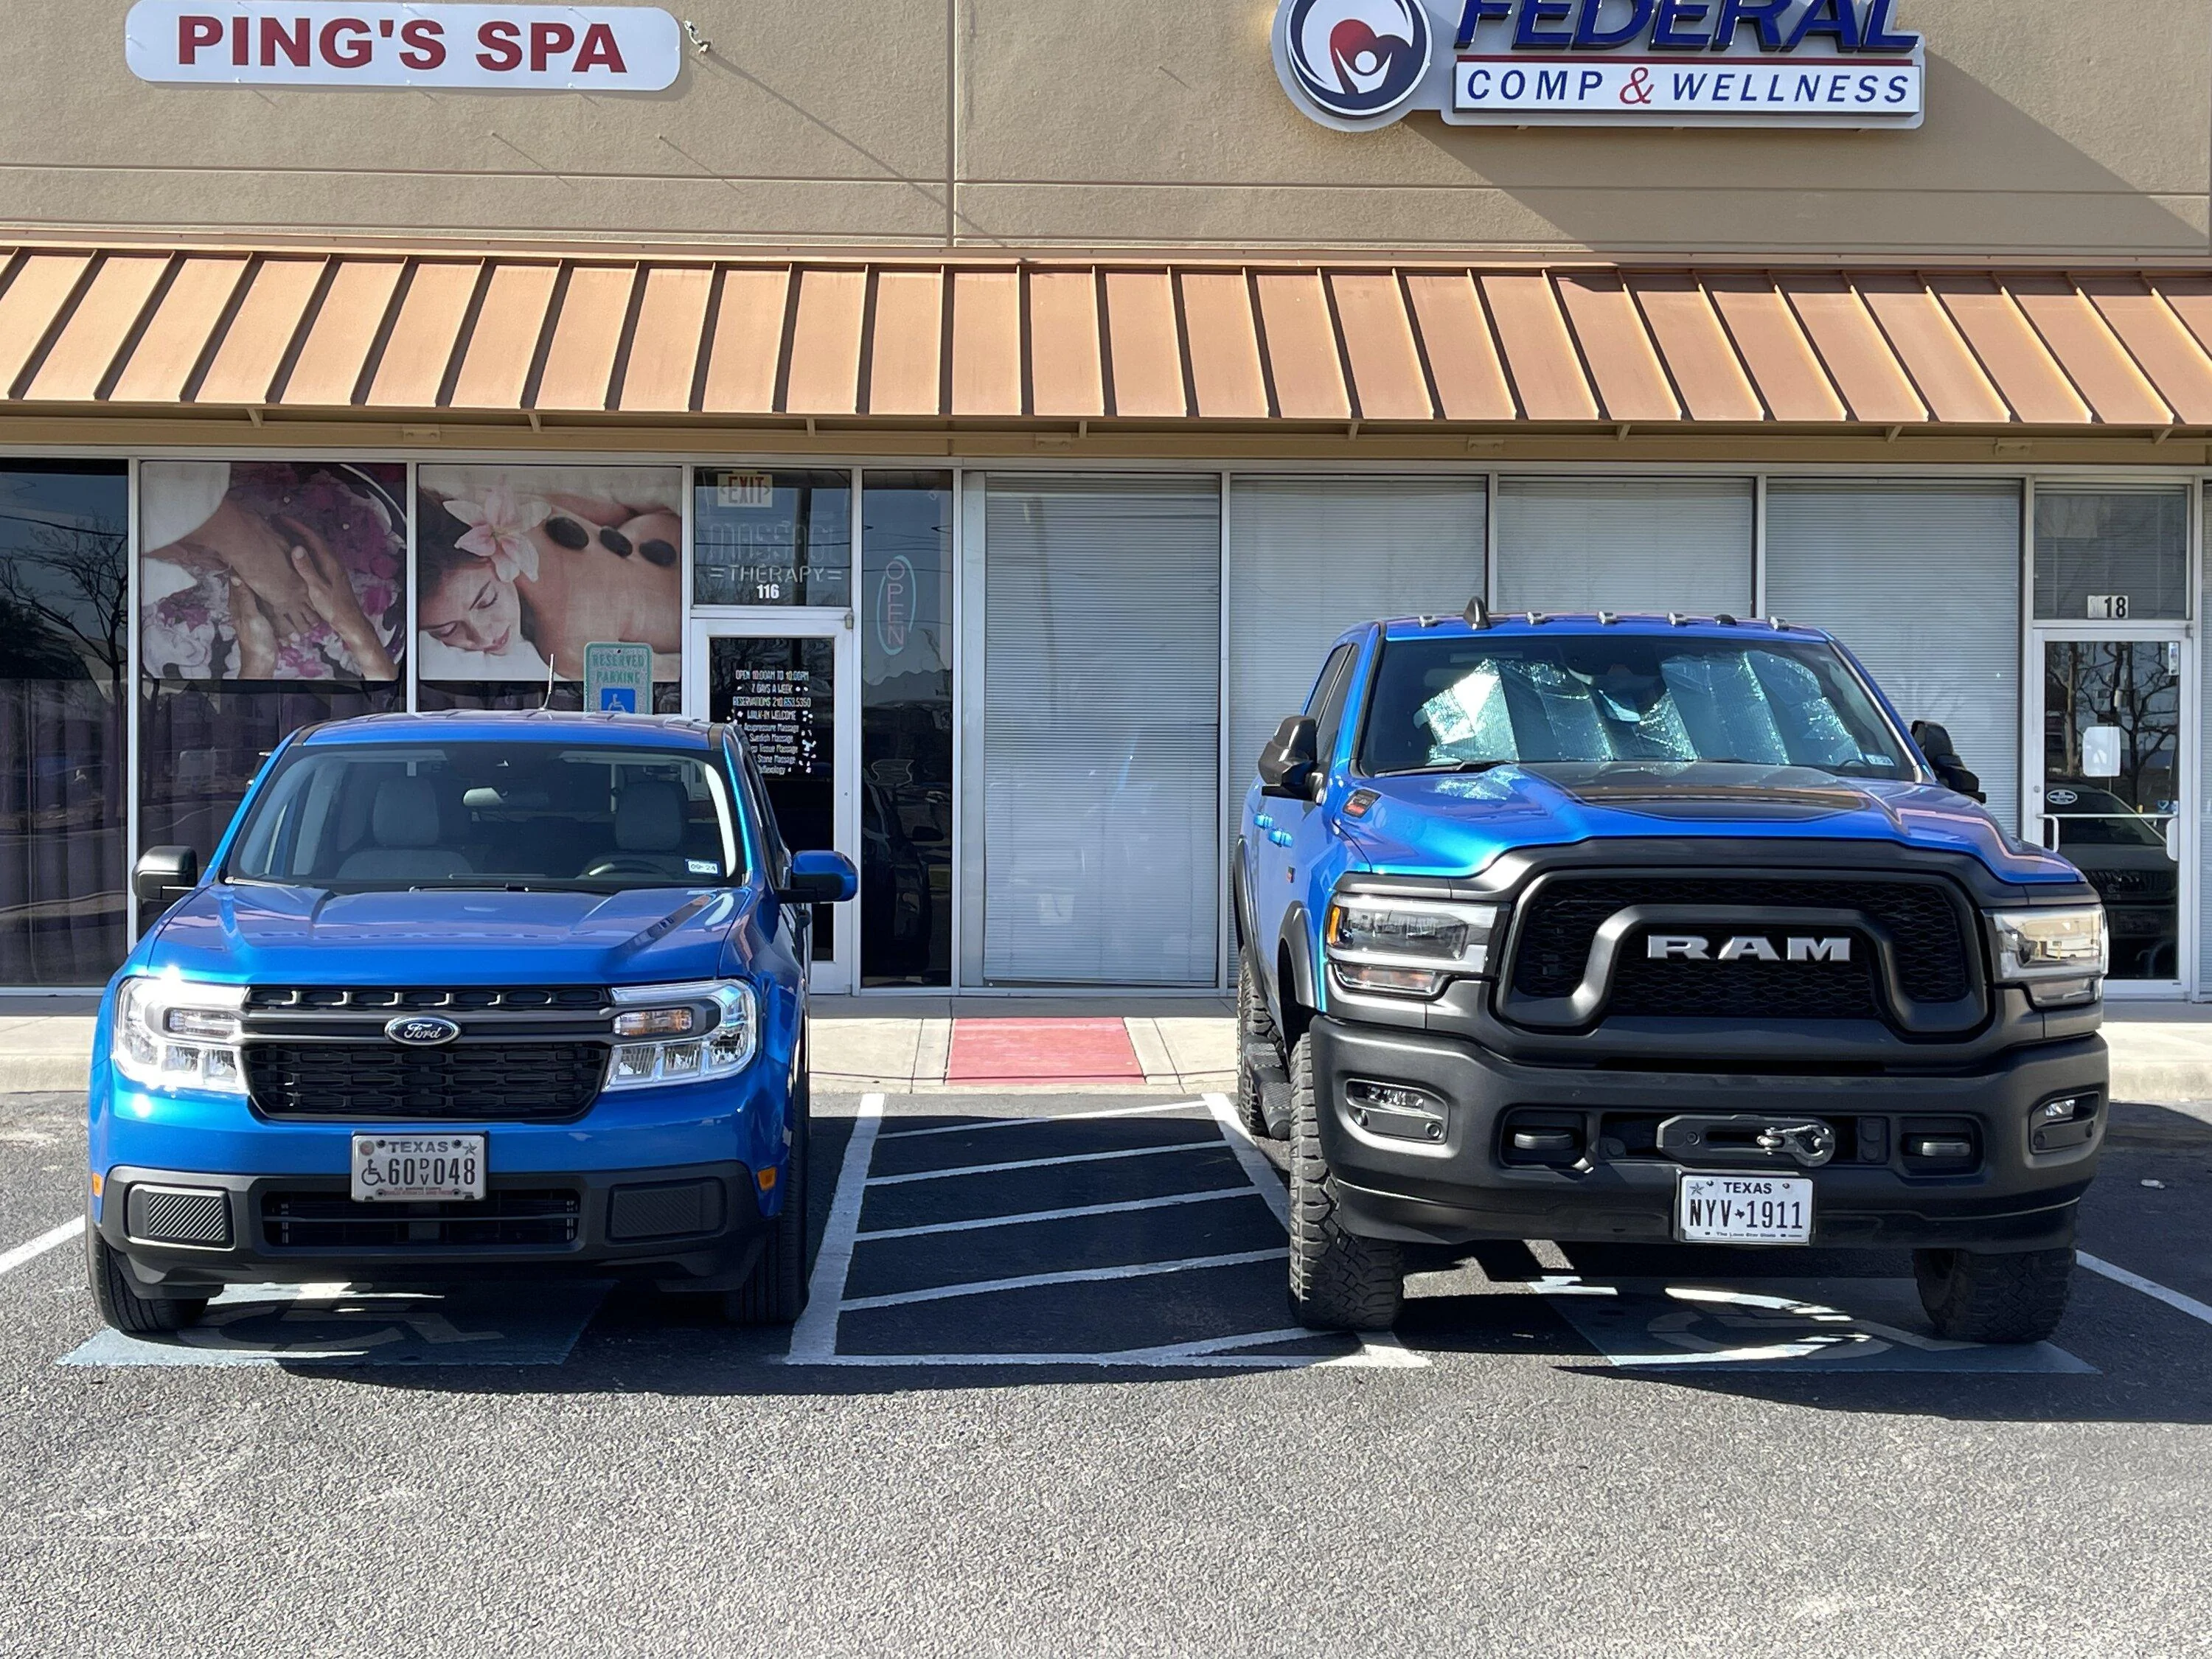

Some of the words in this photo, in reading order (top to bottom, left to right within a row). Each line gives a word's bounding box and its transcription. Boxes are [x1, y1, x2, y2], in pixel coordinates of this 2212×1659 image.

[1454, 0, 1920, 51] FEDERAL
[178, 15, 447, 70] PING'S
[476, 21, 628, 73] SPA
[1467, 69, 1603, 100] COMP
[1619, 66, 1654, 105] &
[1672, 74, 1909, 102] WELLNESS
[728, 476, 764, 504] EXIT
[727, 564, 824, 583] THERAPY
[757, 584, 780, 599] 116
[886, 561, 905, 644] OPEN
[593, 654, 645, 667] RESERVED
[597, 671, 641, 684] PARKING
[1647, 935, 1851, 961] RAM
[404, 1023, 442, 1038] Ford
[388, 1141, 448, 1153] TEXAS
[1723, 1182, 1773, 1194] TEXAS
